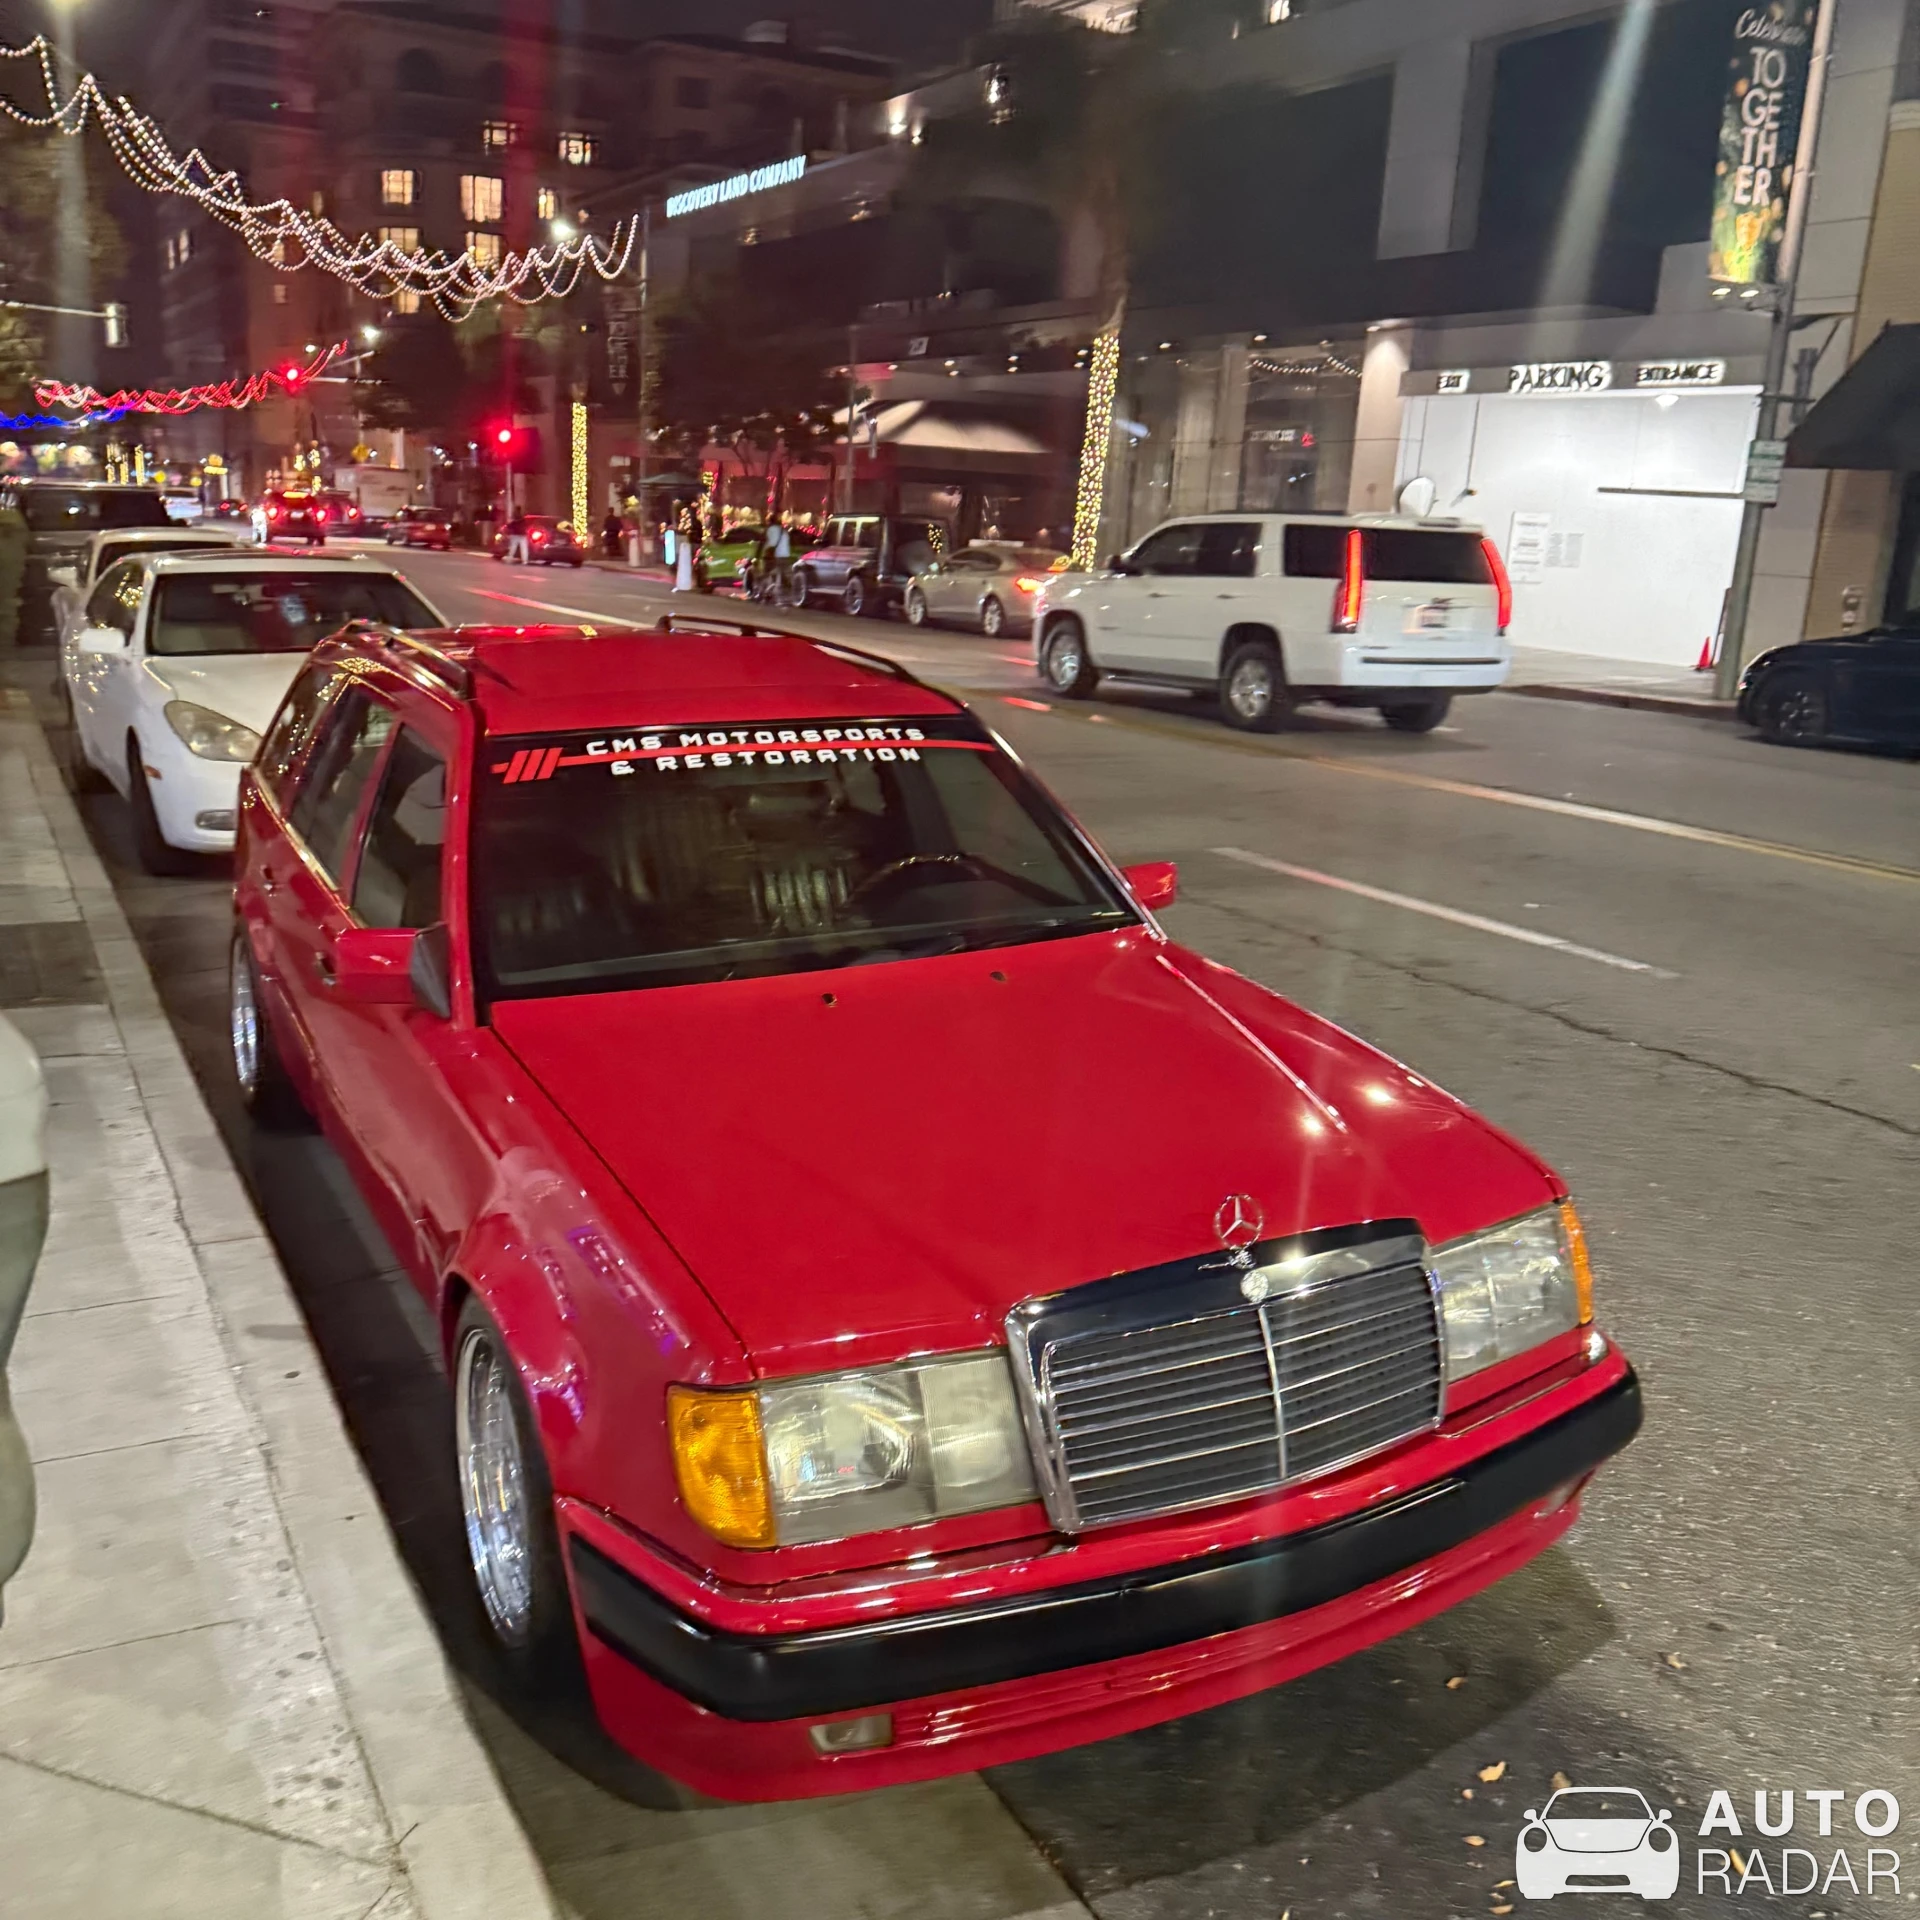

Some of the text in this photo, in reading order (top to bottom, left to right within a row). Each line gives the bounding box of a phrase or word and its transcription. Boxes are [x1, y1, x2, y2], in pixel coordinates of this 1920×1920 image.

[1750, 47, 1787, 89] TO
[1741, 88, 1783, 130] GE
[1740, 126, 1778, 168] TH
[666, 155, 807, 218] DISCOVERY LAND COMPANY
[1733, 164, 1772, 206] ER
[1508, 363, 1607, 390] PARKING
[1635, 362, 1720, 383] ENTRANCE
[586, 728, 925, 757] CMS MOTORSPORTS
[610, 747, 921, 776] & RESTORATION
